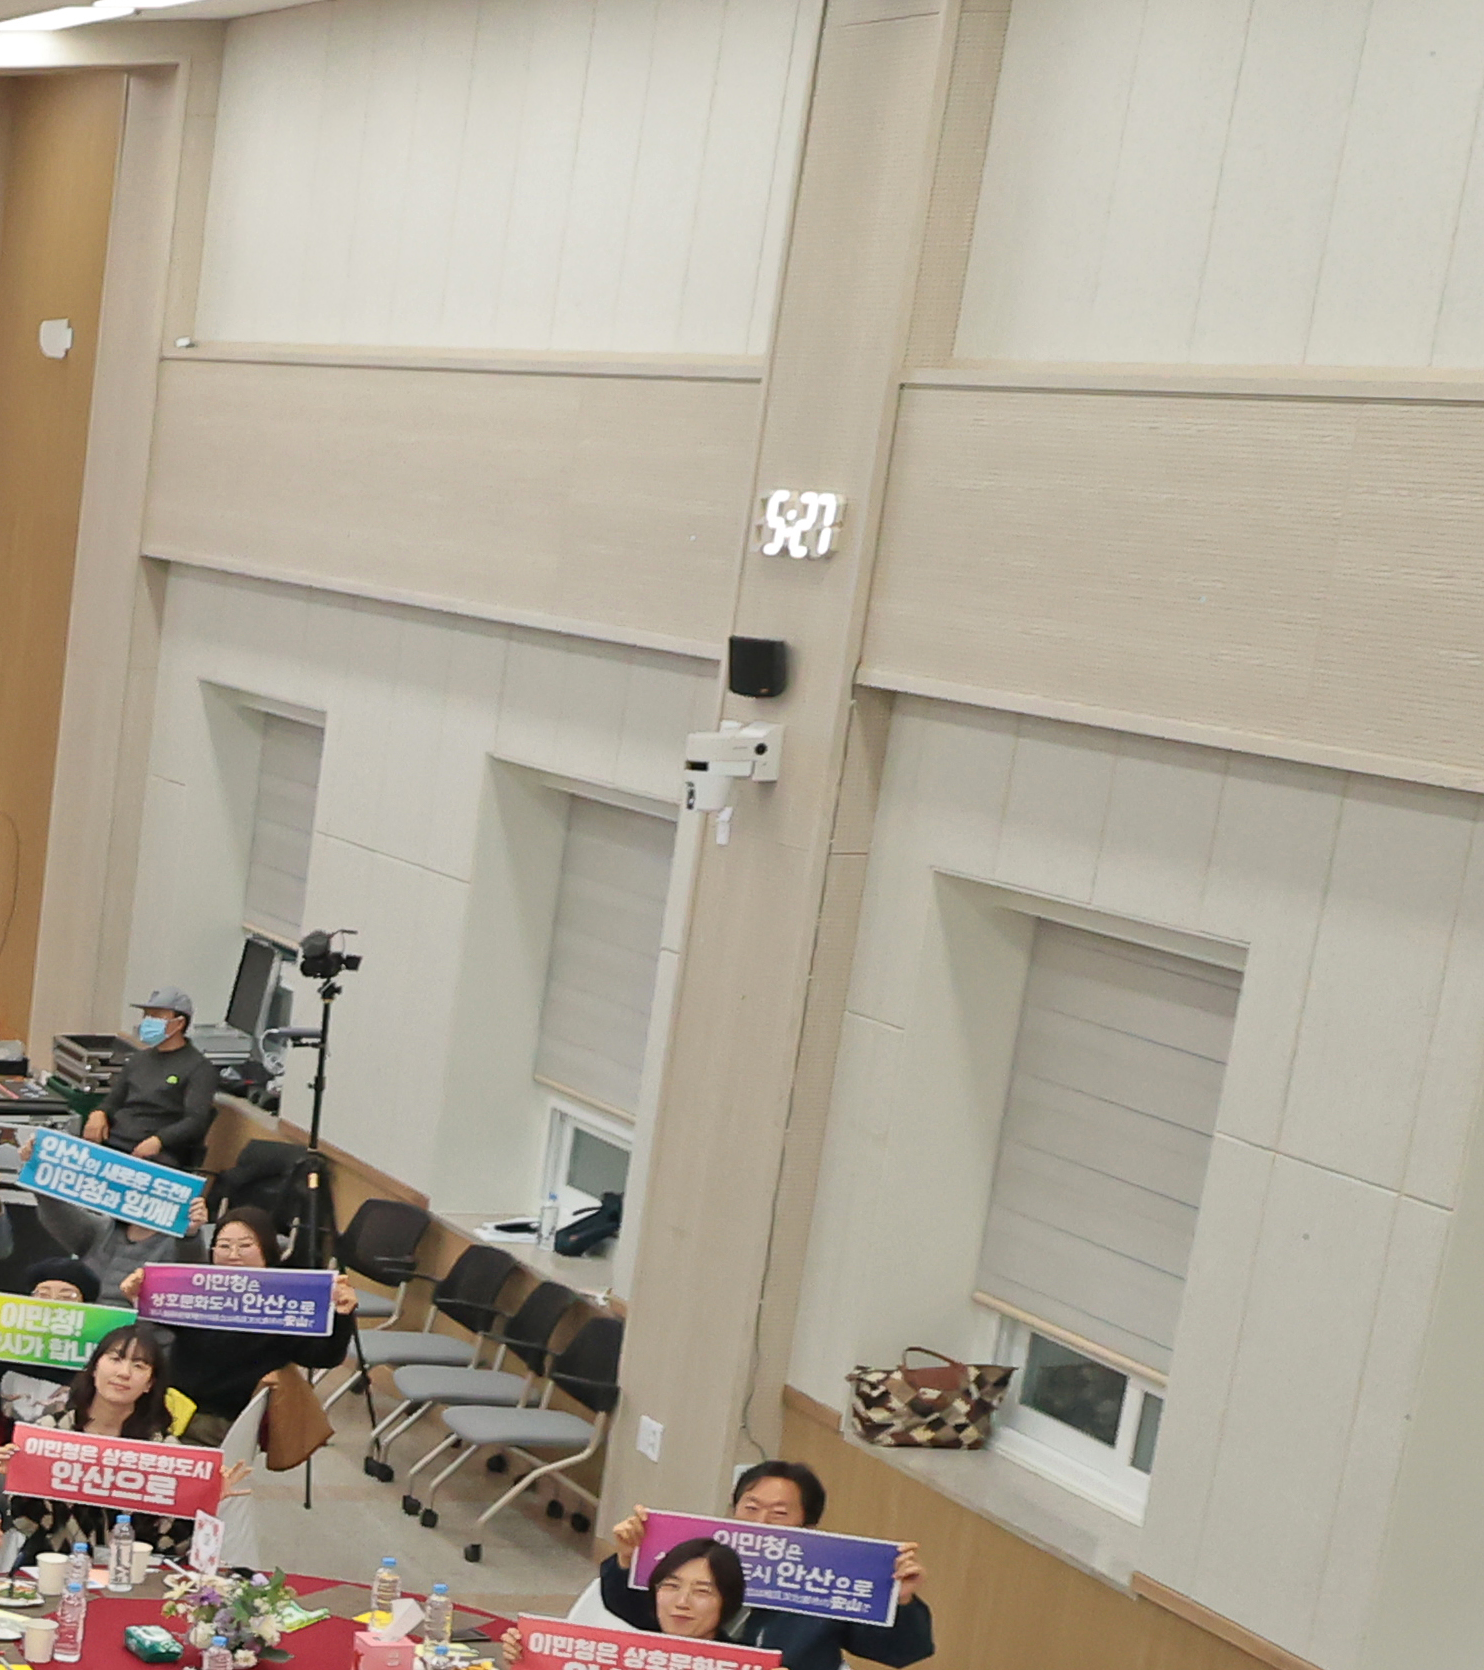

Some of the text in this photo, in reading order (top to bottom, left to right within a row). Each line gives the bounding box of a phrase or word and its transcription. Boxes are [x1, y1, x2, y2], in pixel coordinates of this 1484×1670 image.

[25, 1437, 213, 1481] 이민청은 상호문화도시
[51, 1460, 179, 1506] 안산으로
[528, 1631, 619, 1667] 이민청은
